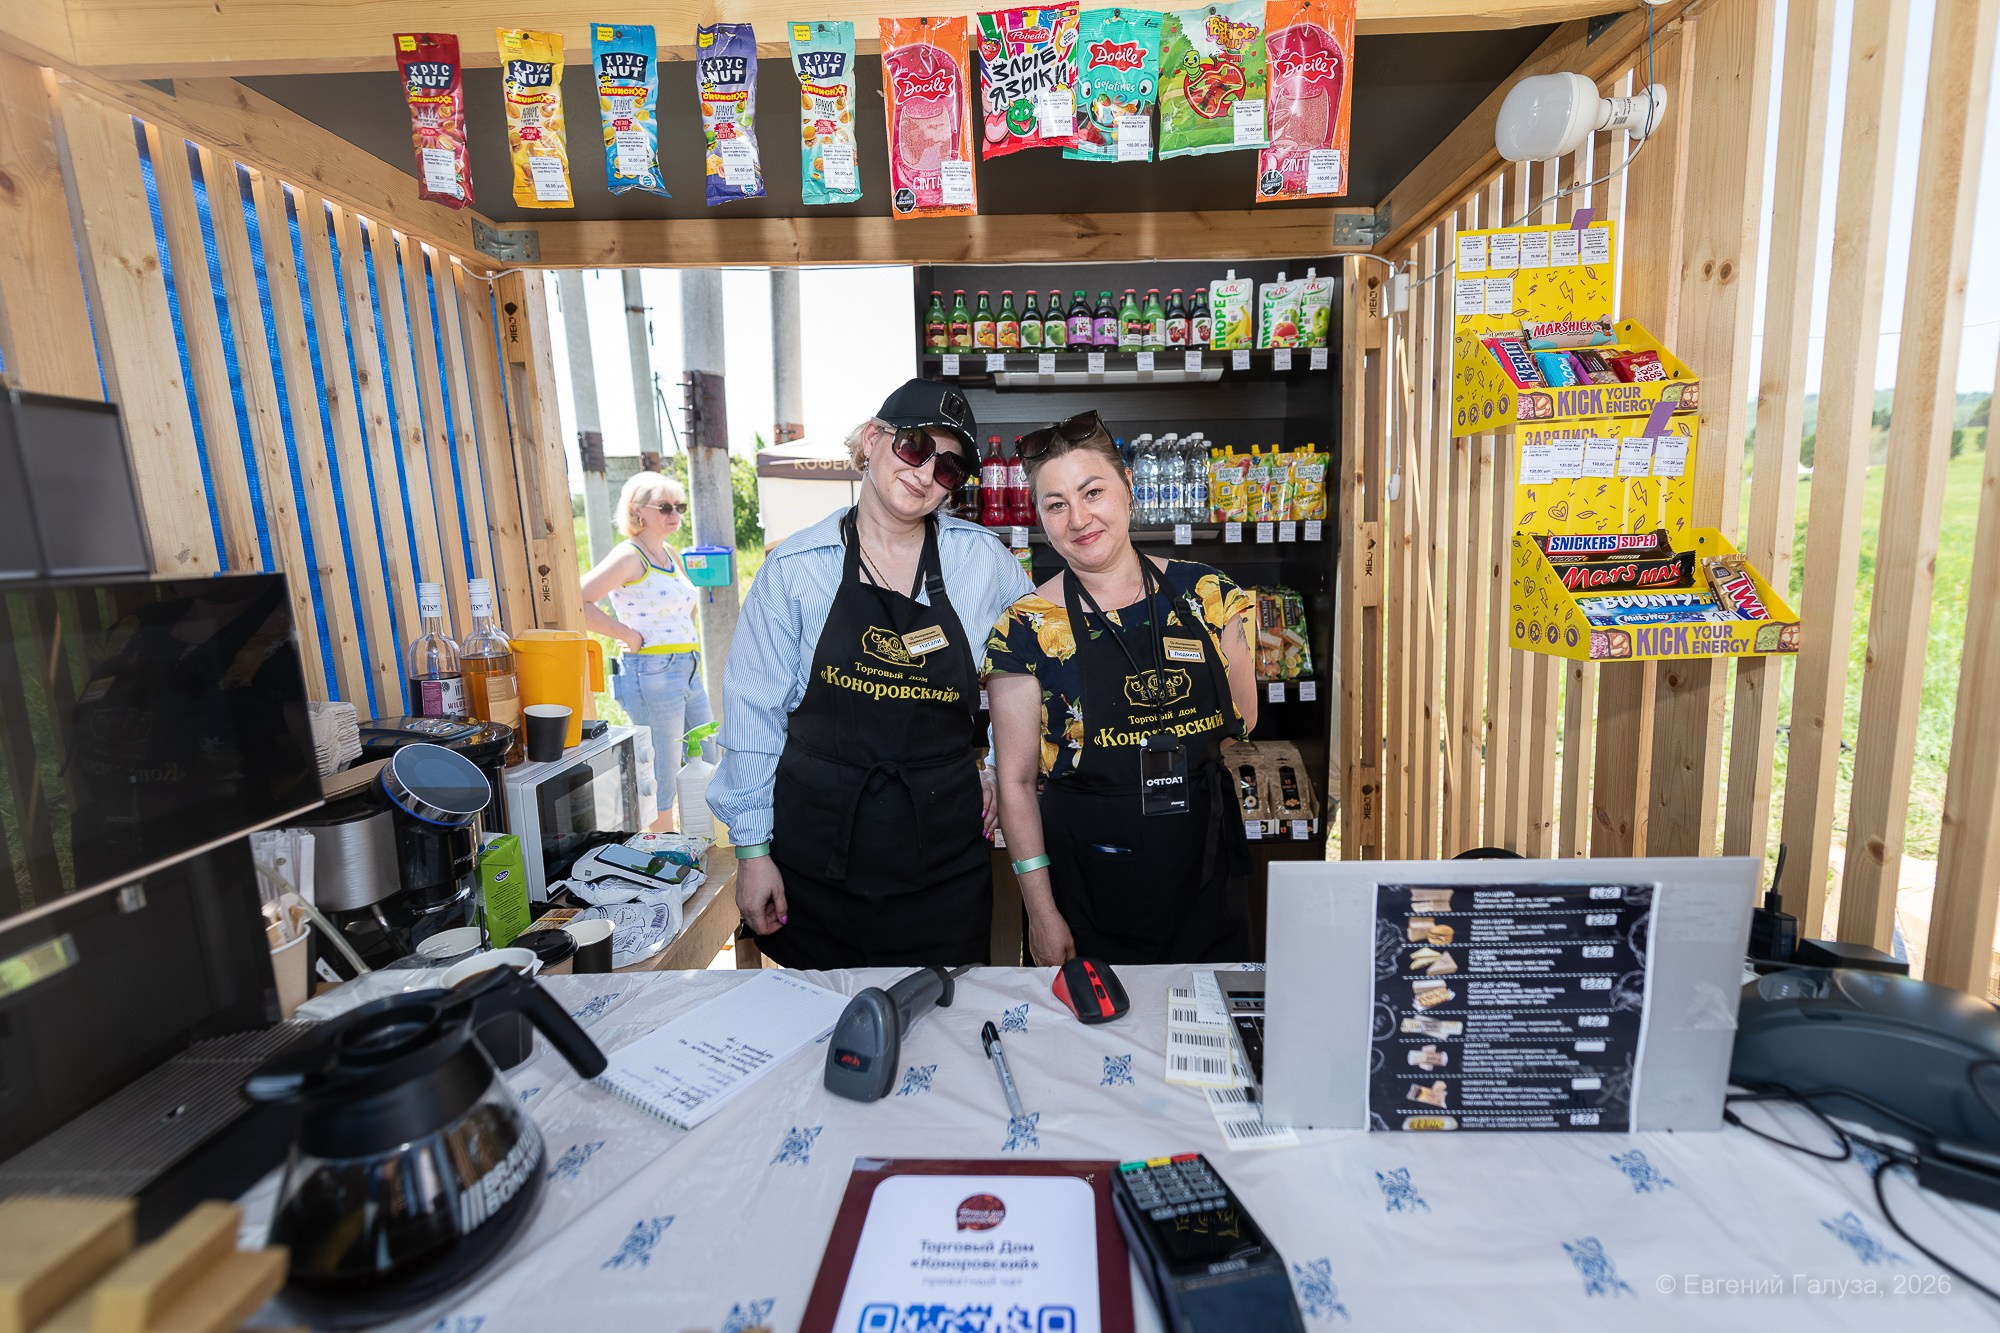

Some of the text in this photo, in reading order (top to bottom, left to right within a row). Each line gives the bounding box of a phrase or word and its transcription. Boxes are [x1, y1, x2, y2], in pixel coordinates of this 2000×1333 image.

[1010, 30, 1048, 42] Pobeda
[1209, 16, 1257, 41] Fashion
[606, 54, 644, 67] ХРУС
[803, 54, 842, 67] ХРУС
[992, 46, 1057, 82] ЗЛЫЕ
[1095, 47, 1139, 65] Docile
[409, 64, 450, 76] ХРУС
[512, 60, 550, 73] ХРУС
[608, 66, 643, 78] NUT
[705, 58, 742, 71] ХРУС
[805, 64, 841, 77] NUT
[1283, 60, 1331, 78] Docile
[413, 76, 449, 86] NUT
[515, 73, 550, 85] NUT
[708, 70, 743, 83] NUT
[903, 77, 947, 98] Docile
[988, 61, 1067, 112] ЯЗЫКИ
[1094, 77, 1135, 93] Gelatines
[613, 99, 632, 112] АРАХИС
[715, 105, 735, 116] АРАХИС
[815, 98, 835, 112] АРАХИС
[1282, 158, 1307, 173] CINT
[1214, 299, 1227, 349] ПЮРЕ
[1261, 301, 1275, 348] ПЮРЕ
[1533, 321, 1593, 337] MARSHICK
[1557, 386, 1641, 417] KICK YOUR
[1605, 398, 1656, 414] ENERGY
[1550, 534, 1657, 551] SNICKERS SUPER
[1562, 560, 1682, 590] Mars MAX
[1602, 592, 1714, 609] BOUNTY Tr
[919, 638, 942, 650] Натали
[1636, 625, 1733, 657] KICK YOUR
[1692, 639, 1750, 654] ENERGY
[854, 661, 929, 683] Торговый дом
[820, 665, 960, 703] «Коноровский»
[1178, 707, 1197, 717] дом
[1093, 709, 1225, 748] «Коновский
[920, 1239, 1034, 1255] Торговый Дом
[910, 1255, 1040, 1273] «Коноровский»
